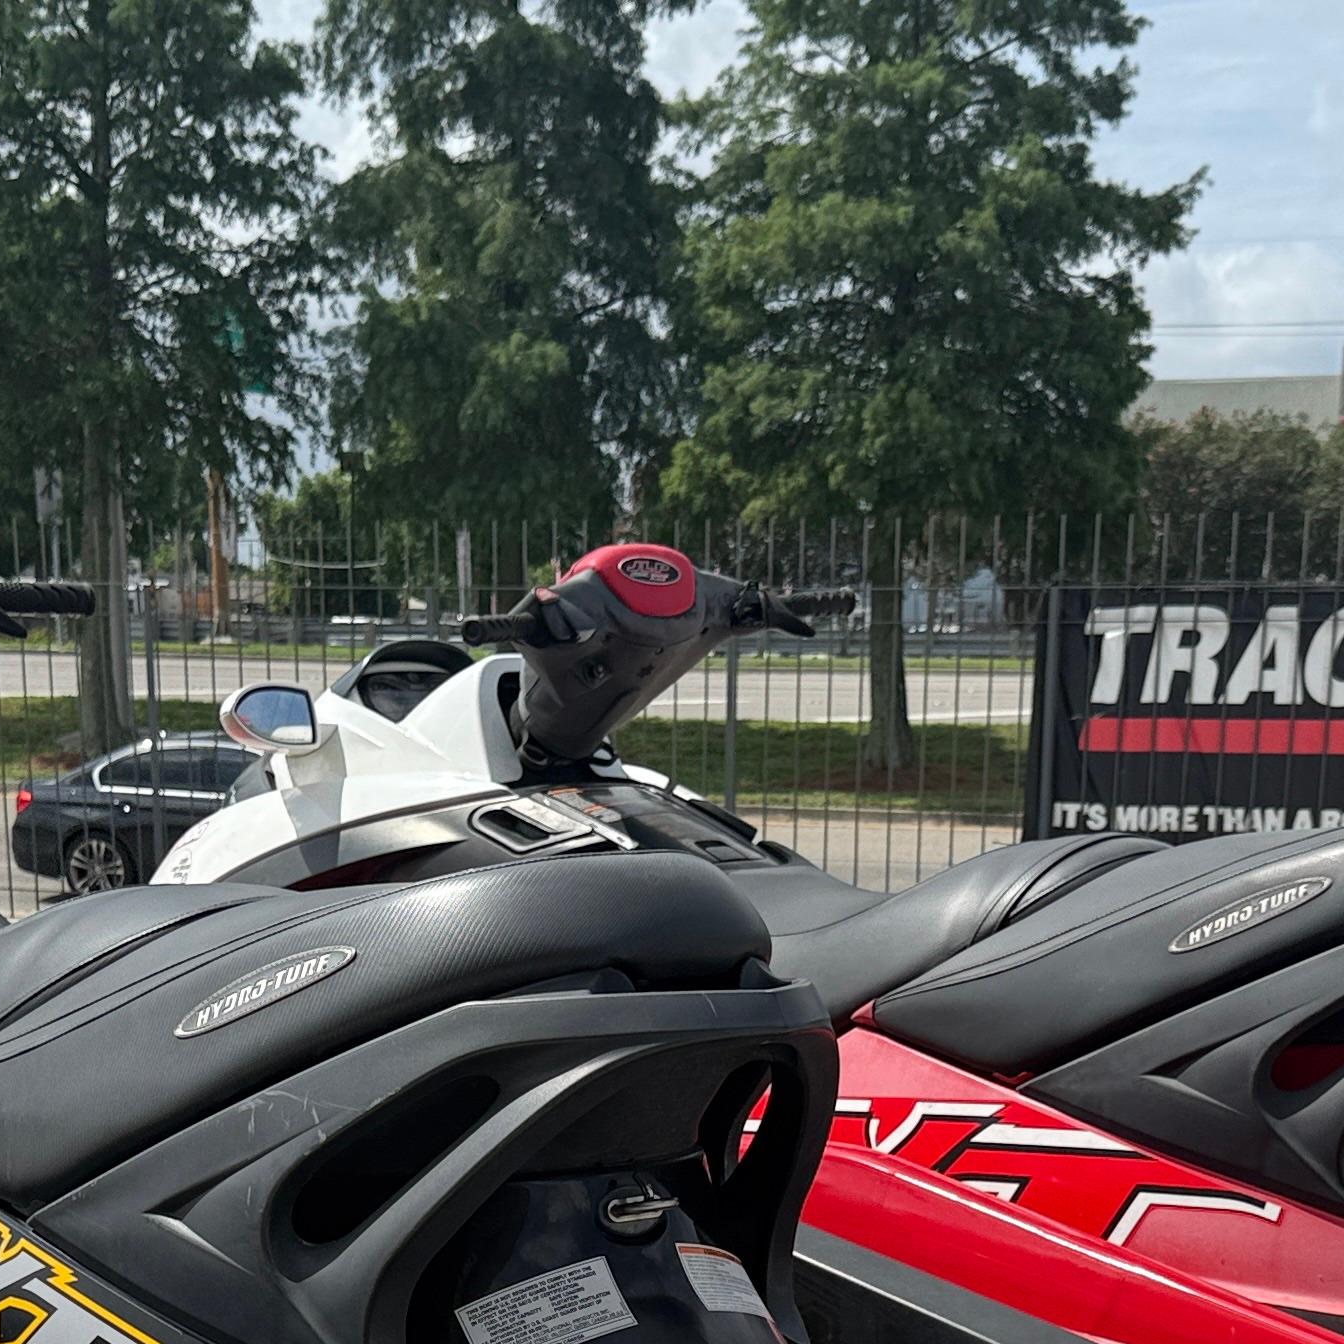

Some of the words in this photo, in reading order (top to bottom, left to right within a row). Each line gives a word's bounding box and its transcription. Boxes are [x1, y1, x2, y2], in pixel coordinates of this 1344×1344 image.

[1051, 802, 1107, 829] IT'S
[1112, 806, 1199, 832] MORE
[1203, 806, 1286, 832] THAN
[1292, 809, 1313, 831] A
[1188, 884, 1310, 945] HYDRO-TURF
[196, 953, 332, 1028] HYDRO-TURF
